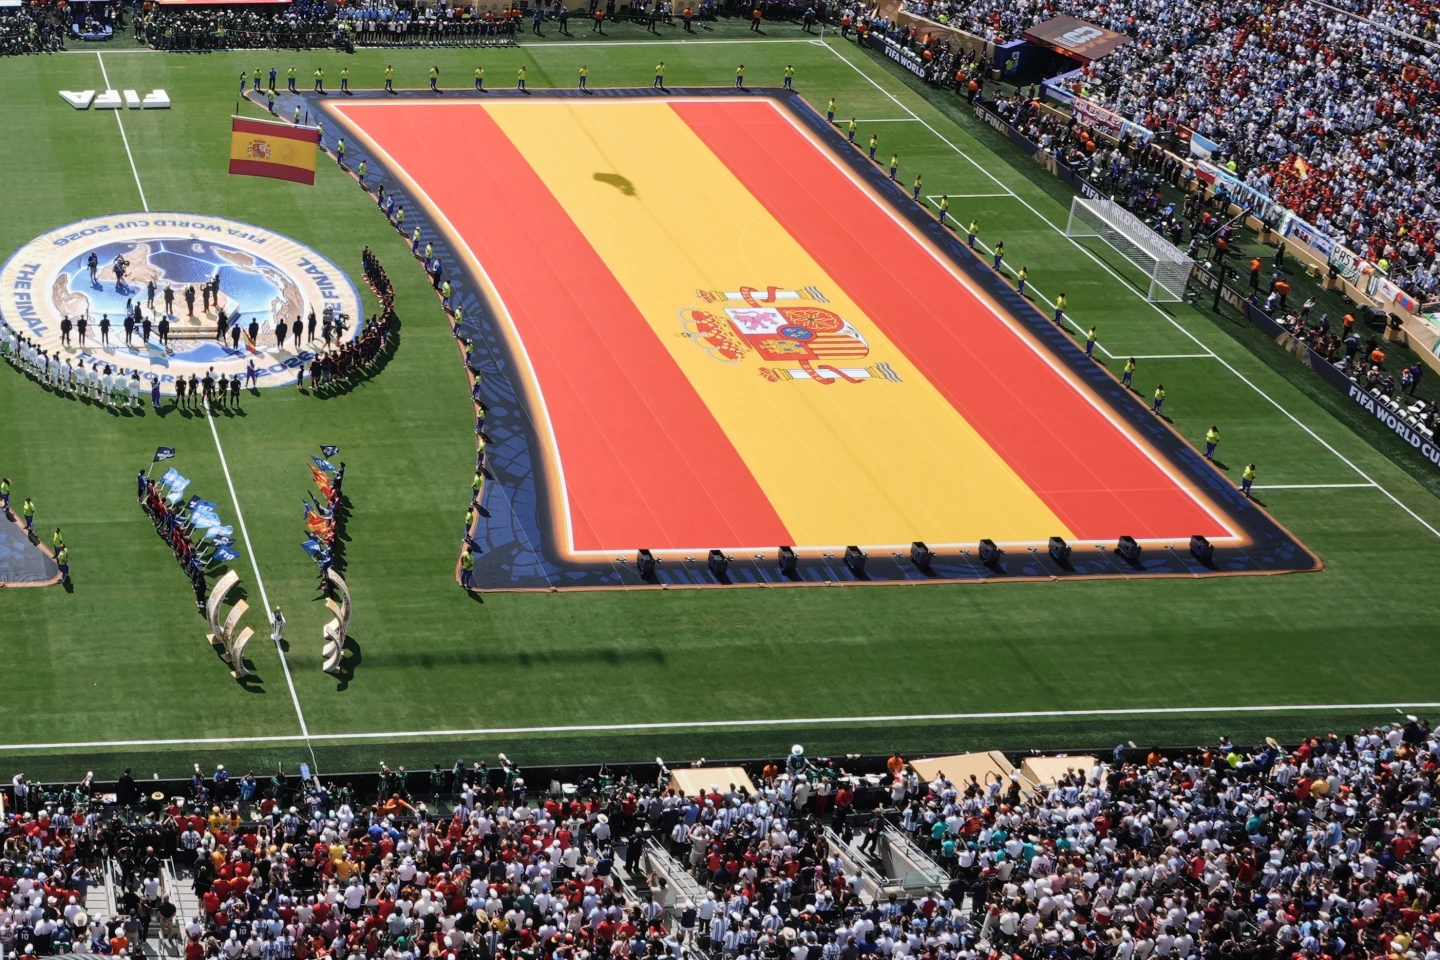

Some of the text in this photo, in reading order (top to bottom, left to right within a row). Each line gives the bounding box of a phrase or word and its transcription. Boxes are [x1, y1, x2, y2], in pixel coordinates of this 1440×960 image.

[885, 46, 925, 78] FIFA WORLD
[58, 89, 171, 109] FIFA
[984, 112, 1010, 138] FINAL
[1081, 182, 1100, 202] FIFA
[53, 218, 267, 247] FIFA WORLD CUP 2026
[297, 256, 339, 299] FINAL
[14, 261, 53, 338] THE FINAL
[1348, 383, 1374, 414] FIFA
[1376, 402, 1421, 447] WORLD
